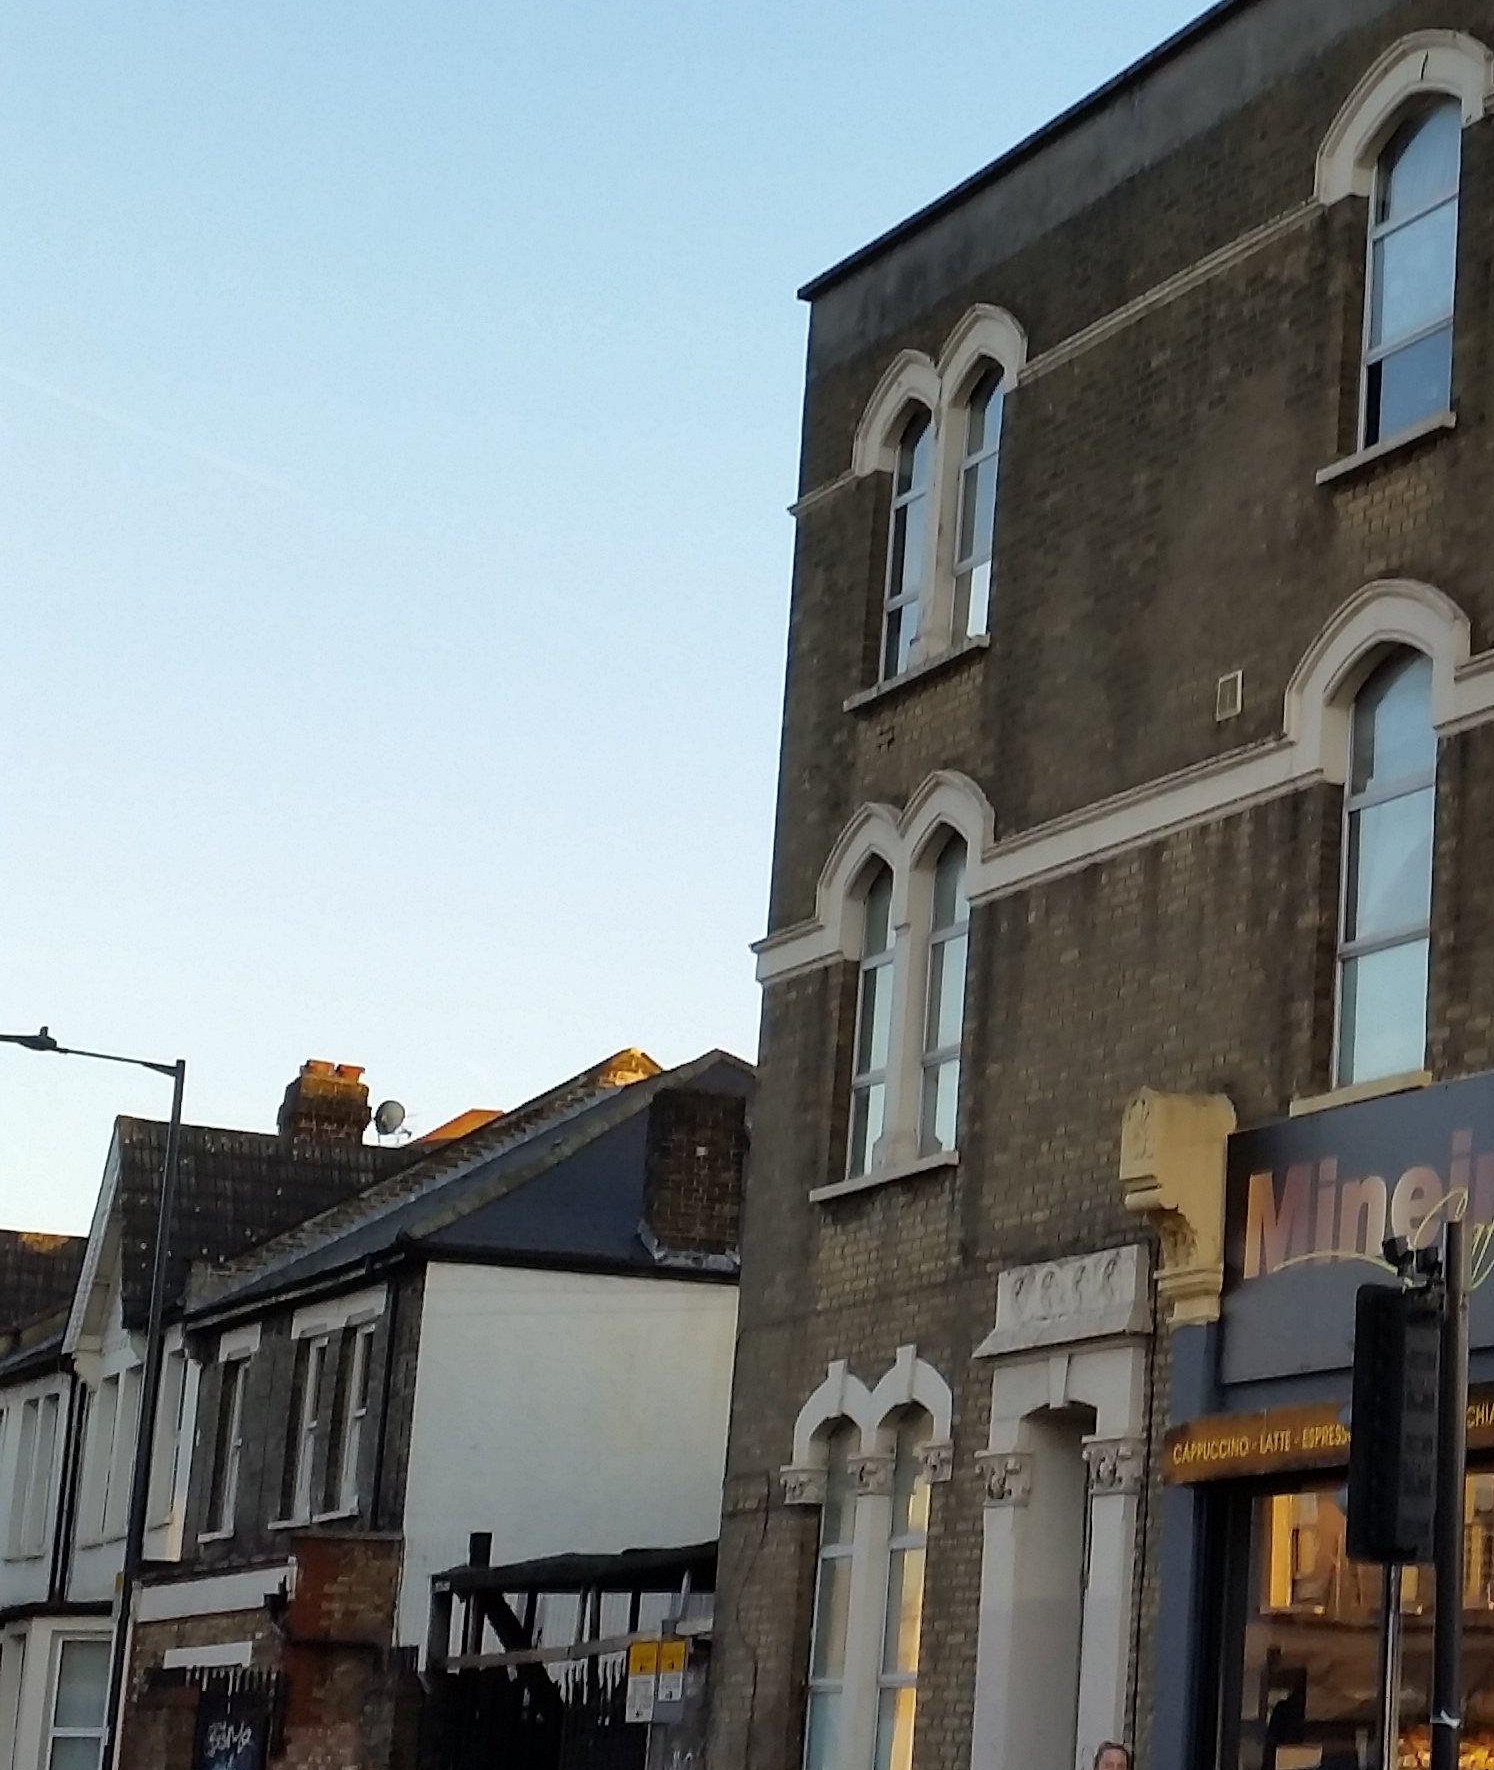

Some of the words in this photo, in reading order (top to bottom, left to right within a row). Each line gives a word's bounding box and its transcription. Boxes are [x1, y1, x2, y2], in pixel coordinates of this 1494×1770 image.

[1173, 1435, 1249, 1466] CAPPUCCINO
[1259, 1430, 1291, 1455] LATTE
[1302, 1424, 1351, 1450] ESPRESS
